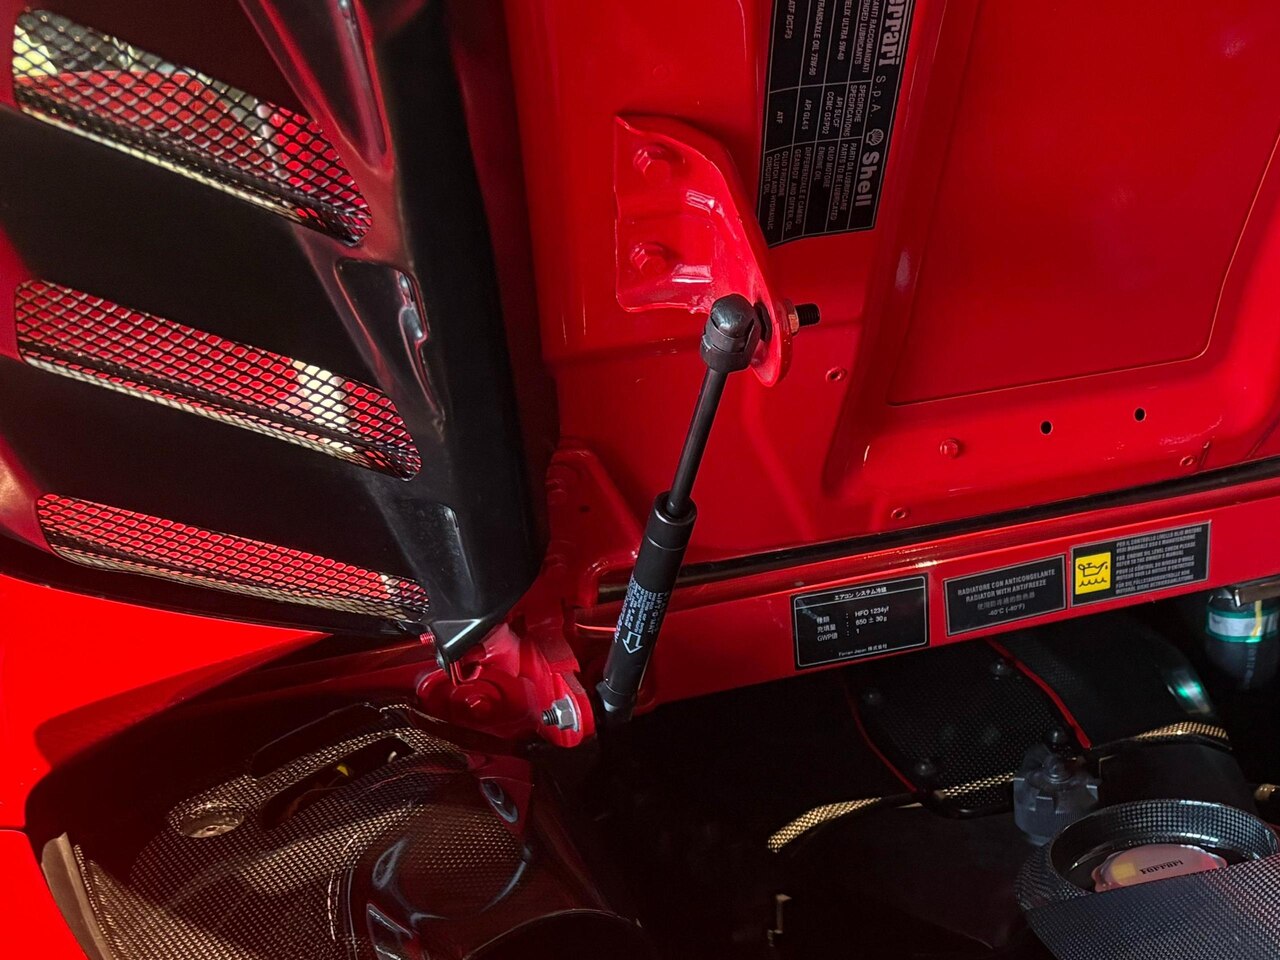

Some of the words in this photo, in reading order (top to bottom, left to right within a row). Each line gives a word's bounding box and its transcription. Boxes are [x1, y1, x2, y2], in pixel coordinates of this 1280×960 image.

[870, 0, 879, 16] ANTI
[784, 14, 793, 39] DCT-F3
[839, 18, 849, 39] ULTRA
[811, 39, 820, 51] OIL
[837, 40, 845, 60] 5W-40
[854, 22, 866, 64] LUBRICANTS
[861, 18, 876, 72] RACCOMANDATI
[808, 52, 818, 75] 75W-90
[804, 99, 812, 110] API
[825, 91, 834, 111] CCMC
[835, 96, 843, 107] API
[842, 84, 857, 136] SPECIFICATIONS
[854, 84, 866, 122] SPECIFICHE
[775, 111, 783, 124] ATF
[815, 146, 825, 169] ENGINE
[826, 145, 835, 161] OLIO
[838, 143, 848, 163] PARTS
[847, 142, 857, 160] PARTI
[771, 153, 780, 179] CLUTCH
[791, 148, 801, 179] GEARBOX
[799, 146, 811, 193] DIFFERENZIALE
[837, 164, 844, 173] TO
[846, 161, 853, 171] DA
[813, 170, 821, 181] OIL
[822, 161, 833, 188] MOTORE
[835, 174, 843, 183] BE
[854, 150, 880, 207] Shell
[839, 171, 852, 211] LUBRIFICARE
[829, 184, 841, 221] LUBRICATED
[957, 582, 990, 596] RADIATORE
[991, 579, 1004, 588] CON
[1004, 568, 1055, 585] ANTICONGELANTE
[965, 590, 995, 602] RADIATOR
[996, 586, 1011, 595] WITH
[1012, 578, 1046, 592] ANTIFREEZE
[834, 591, 854, 600] エアコン
[854, 609, 868, 617] HFO
[870, 605, 889, 615] 1234yf
[1140, 860, 1184, 875] Ferrari
